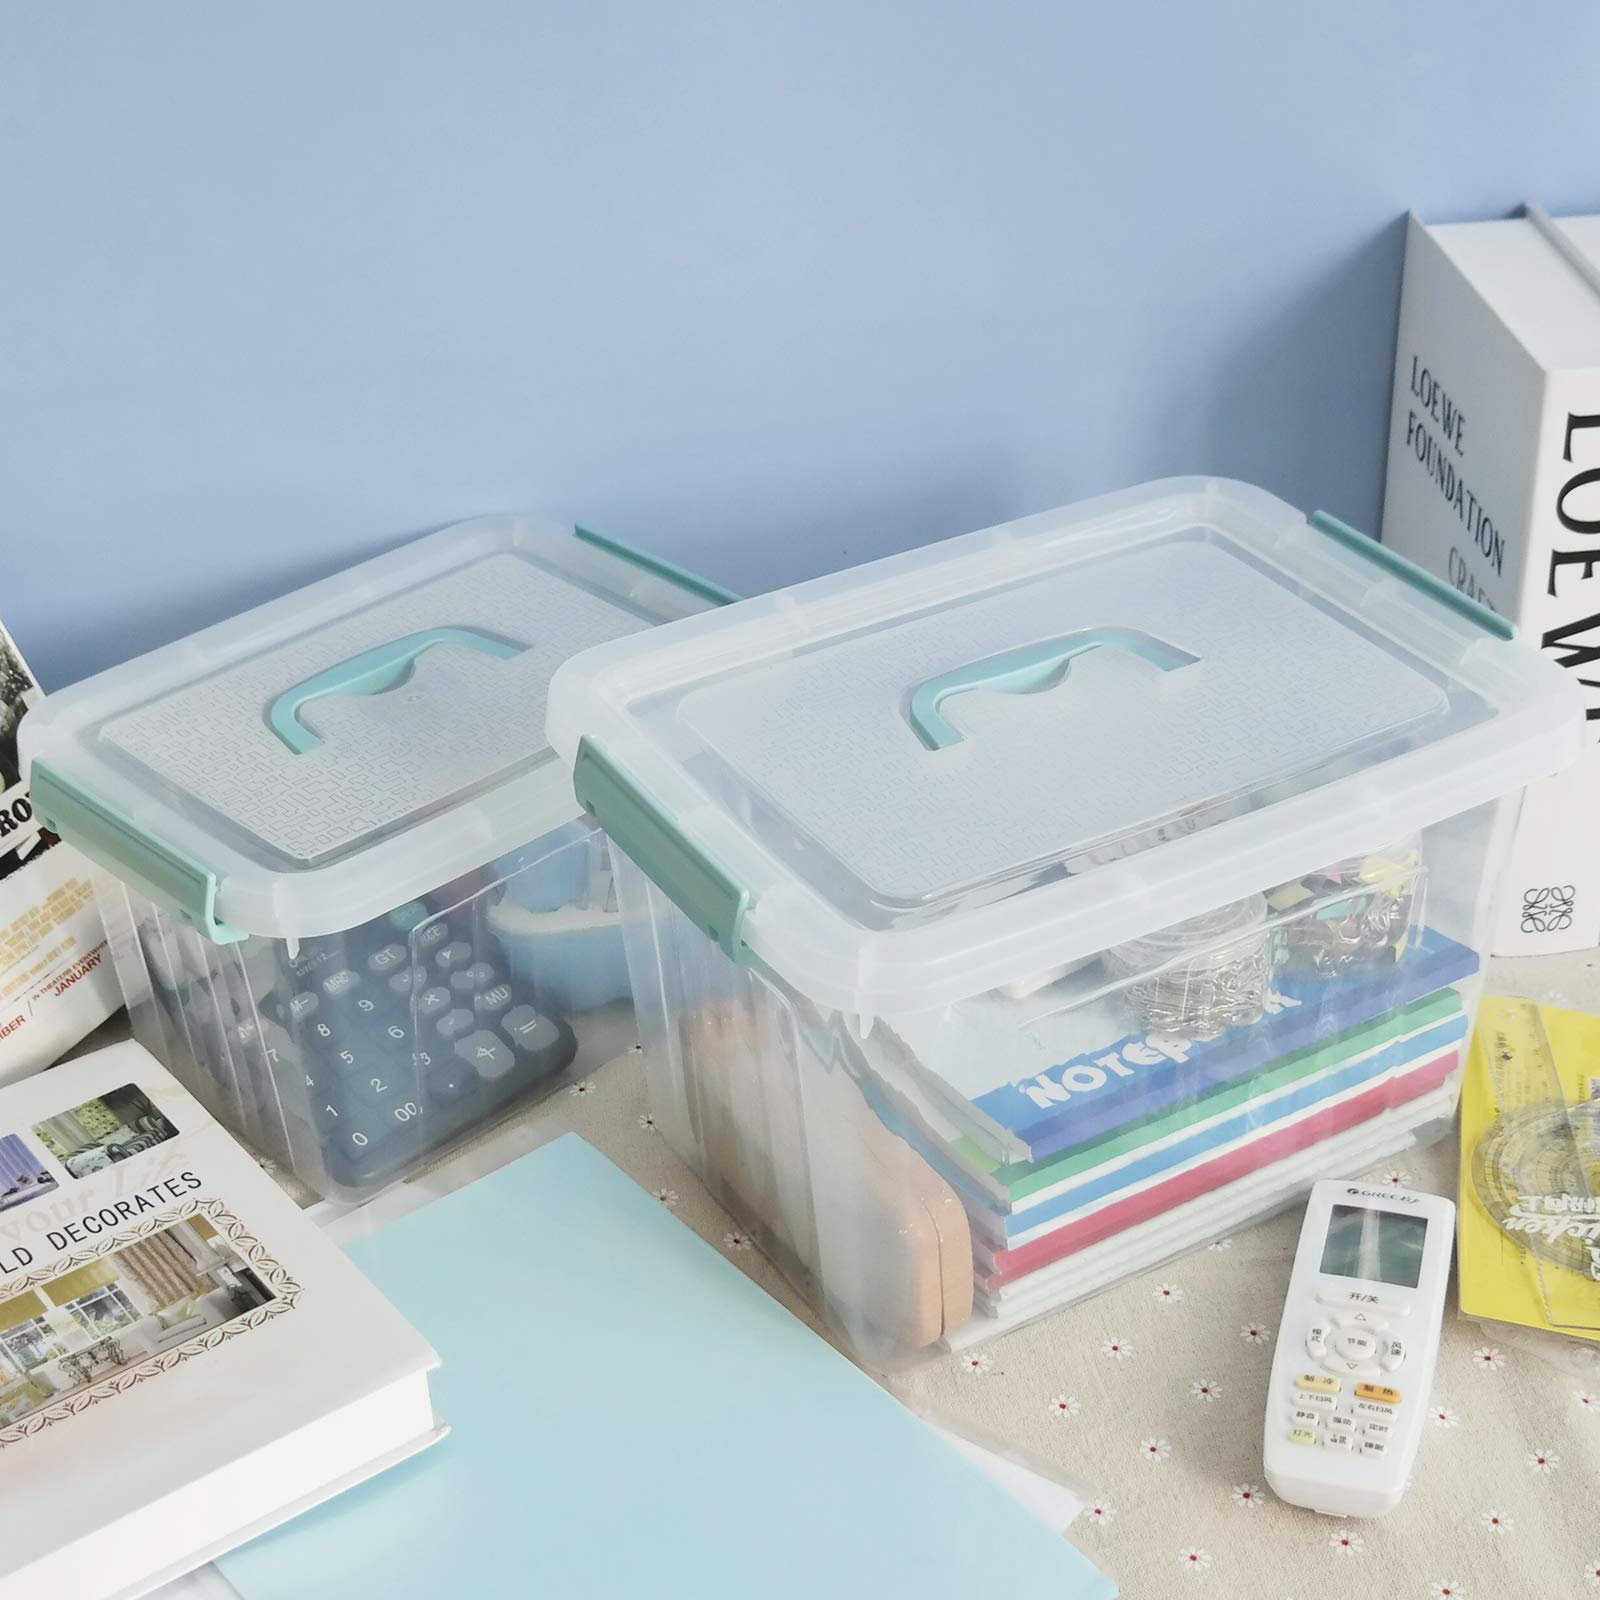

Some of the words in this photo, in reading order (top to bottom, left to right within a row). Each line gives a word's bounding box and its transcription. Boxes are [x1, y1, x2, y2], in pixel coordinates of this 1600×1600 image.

[1411, 355, 1465, 457] LOEWE
[1406, 410, 1505, 578] FOUNDATION
[1448, 546, 1496, 613] CRA
[1540, 411, 1600, 745] LOEW
[0, 792, 33, 838] RO
[374, 948, 397, 966] GT
[54, 953, 102, 997] JANUARY
[485, 986, 509, 1006] MU
[358, 999, 375, 1012] 9
[317, 1023, 332, 1037] 8
[387, 1025, 405, 1039] 6
[340, 1050, 354, 1064] 5
[420, 1051, 432, 1065] 3
[305, 1074, 316, 1087] 4
[370, 1078, 388, 1093] 2
[325, 1104, 338, 1117] 1
[394, 1102, 418, 1121] 00
[351, 1132, 369, 1146] 0
[46, 1171, 202, 1251] DECORATES
[1349, 1292, 1380, 1305] 开/关
